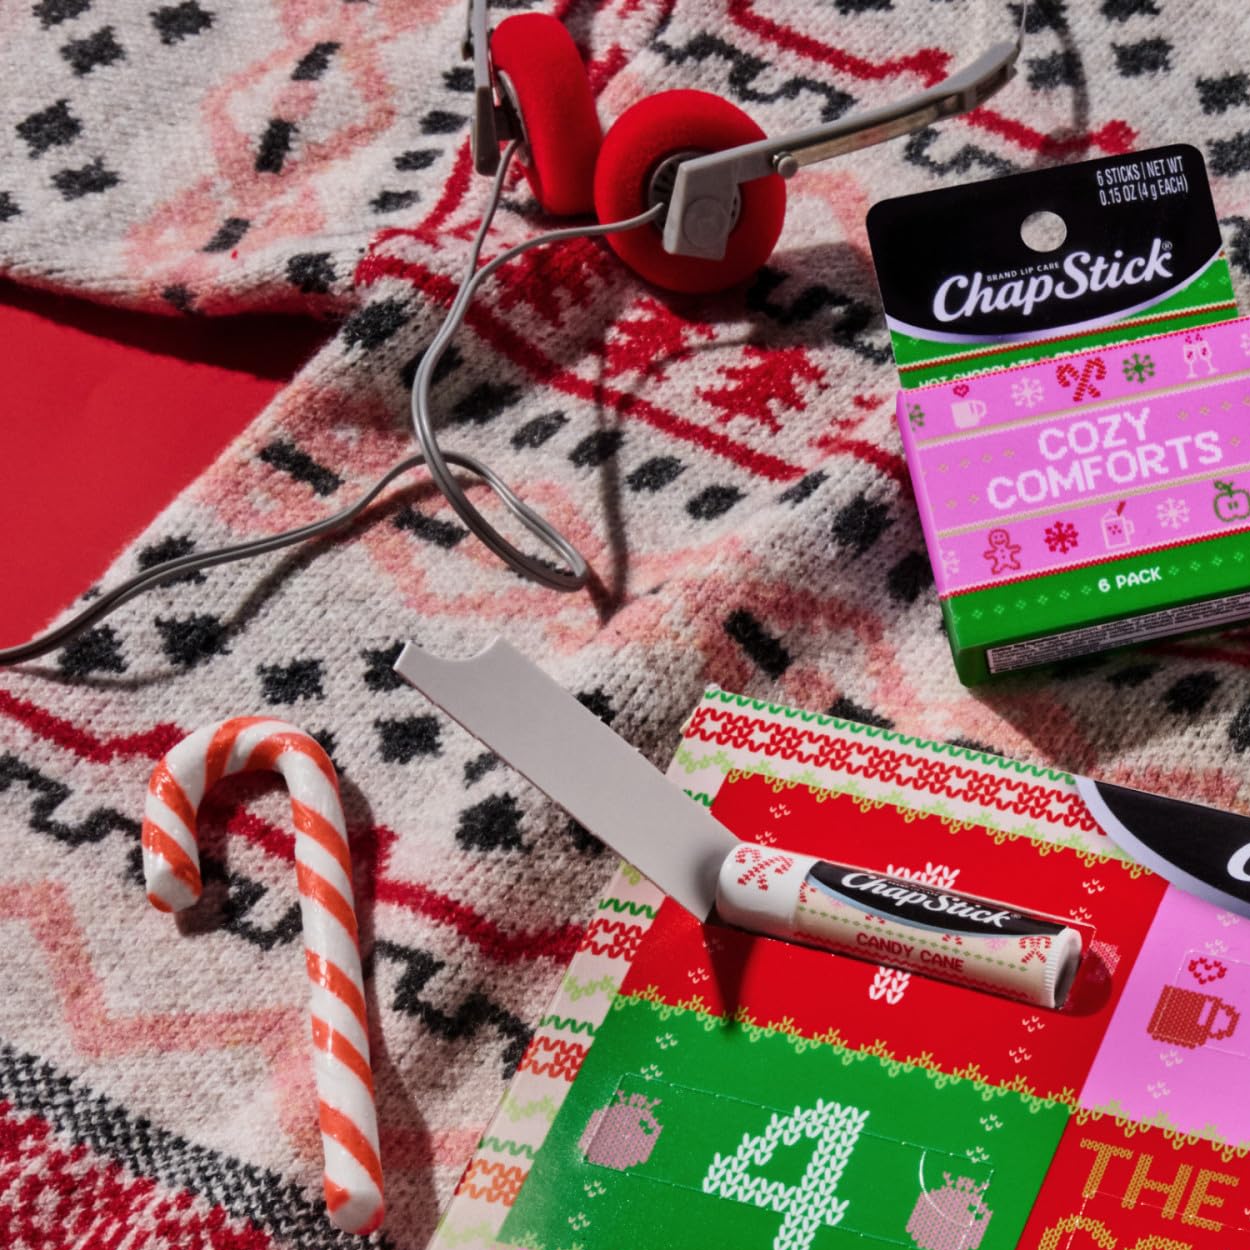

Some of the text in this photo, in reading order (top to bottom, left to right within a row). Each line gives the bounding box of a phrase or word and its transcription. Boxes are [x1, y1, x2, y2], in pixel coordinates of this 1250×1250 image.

[1096, 170, 1104, 187] 6
[1104, 163, 1141, 186] STICKS
[1146, 159, 1166, 178] NET
[1167, 155, 1184, 174] WT
[1099, 173, 1189, 207] 0.15 OZ (4 g EACH)
[986, 261, 1060, 282] BRAND LIP CARE
[1038, 407, 1151, 461] COZY
[986, 430, 1223, 510] COMFORTS
[1097, 566, 1163, 593] 6 PACK
[856, 932, 965, 973] CANDY CANE
[1079, 1138, 1239, 1232] THE
